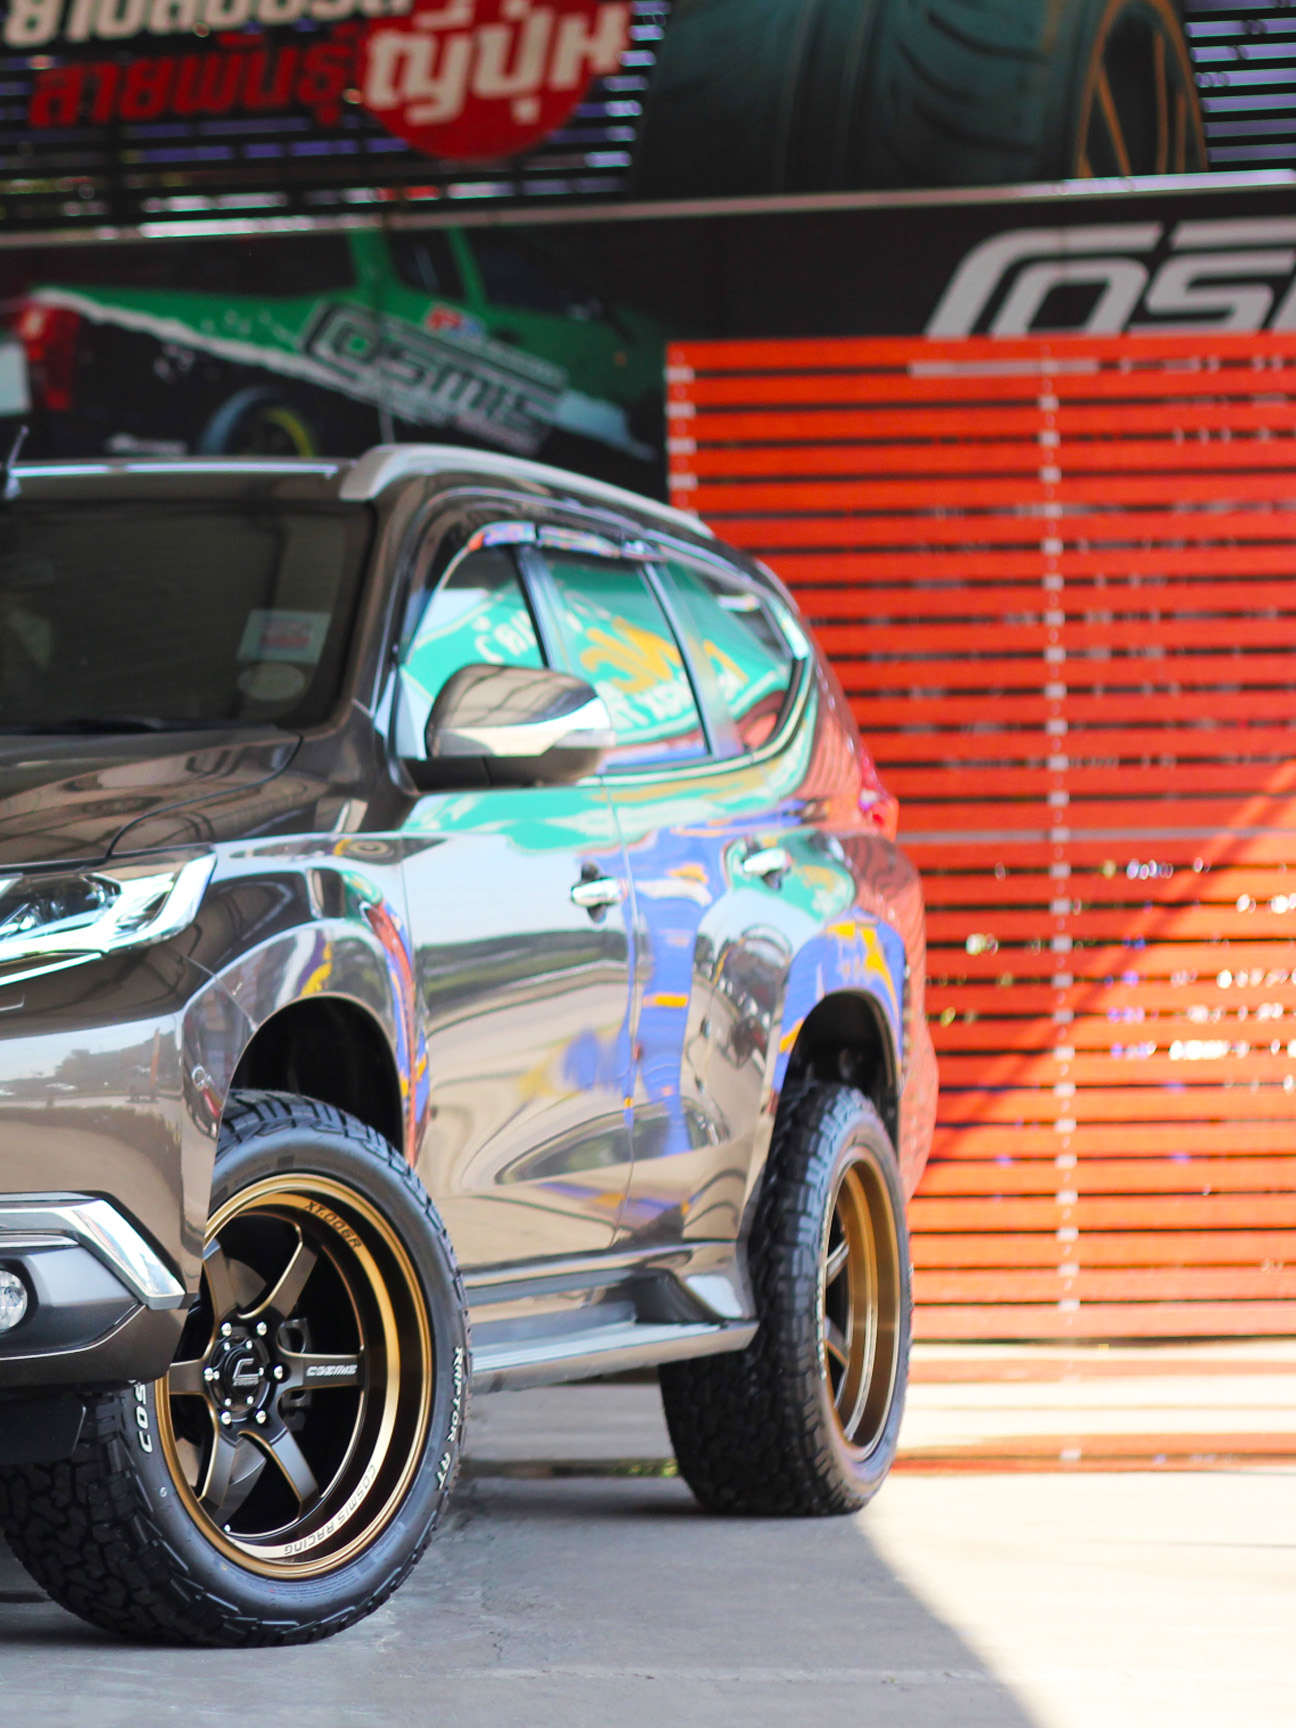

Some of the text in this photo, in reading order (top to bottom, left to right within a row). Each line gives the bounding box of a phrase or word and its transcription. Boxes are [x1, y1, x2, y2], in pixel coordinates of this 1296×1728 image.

[446, 1346, 463, 1442] RAPTOR
[284, 1464, 376, 1555] COSMIS RACING
